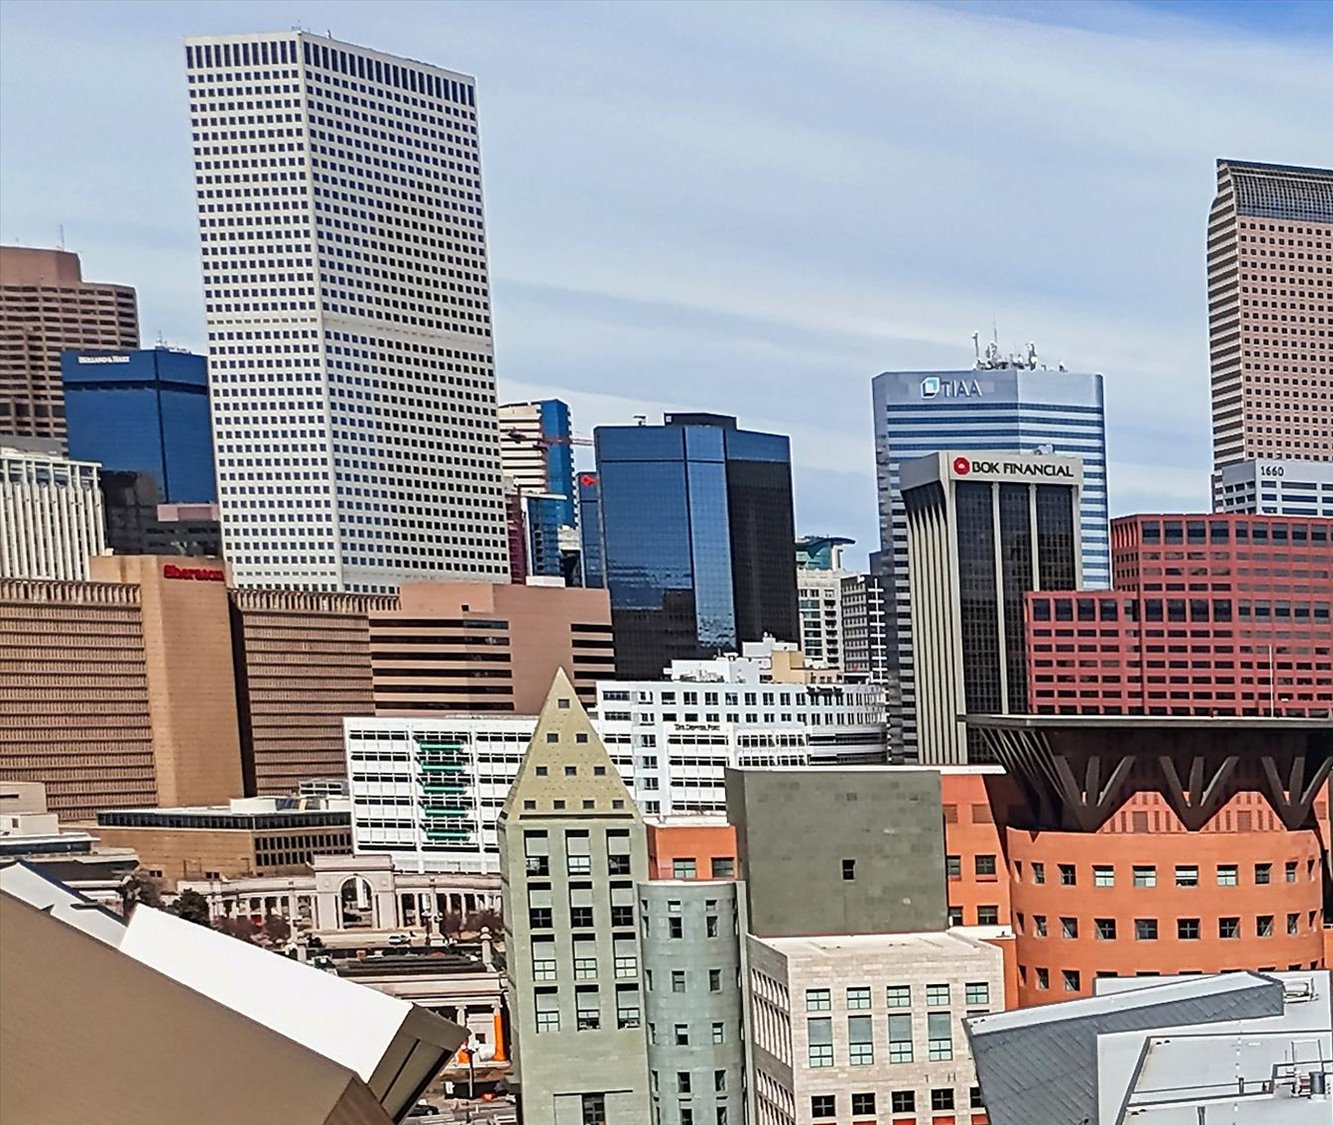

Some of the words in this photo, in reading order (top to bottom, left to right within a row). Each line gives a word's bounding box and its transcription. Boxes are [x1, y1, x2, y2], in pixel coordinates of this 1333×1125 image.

[941, 379, 982, 398] TIAA
[972, 461, 999, 474] BOK
[1003, 462, 1074, 477] FINANCIAL
[1261, 466, 1284, 477] 1660
